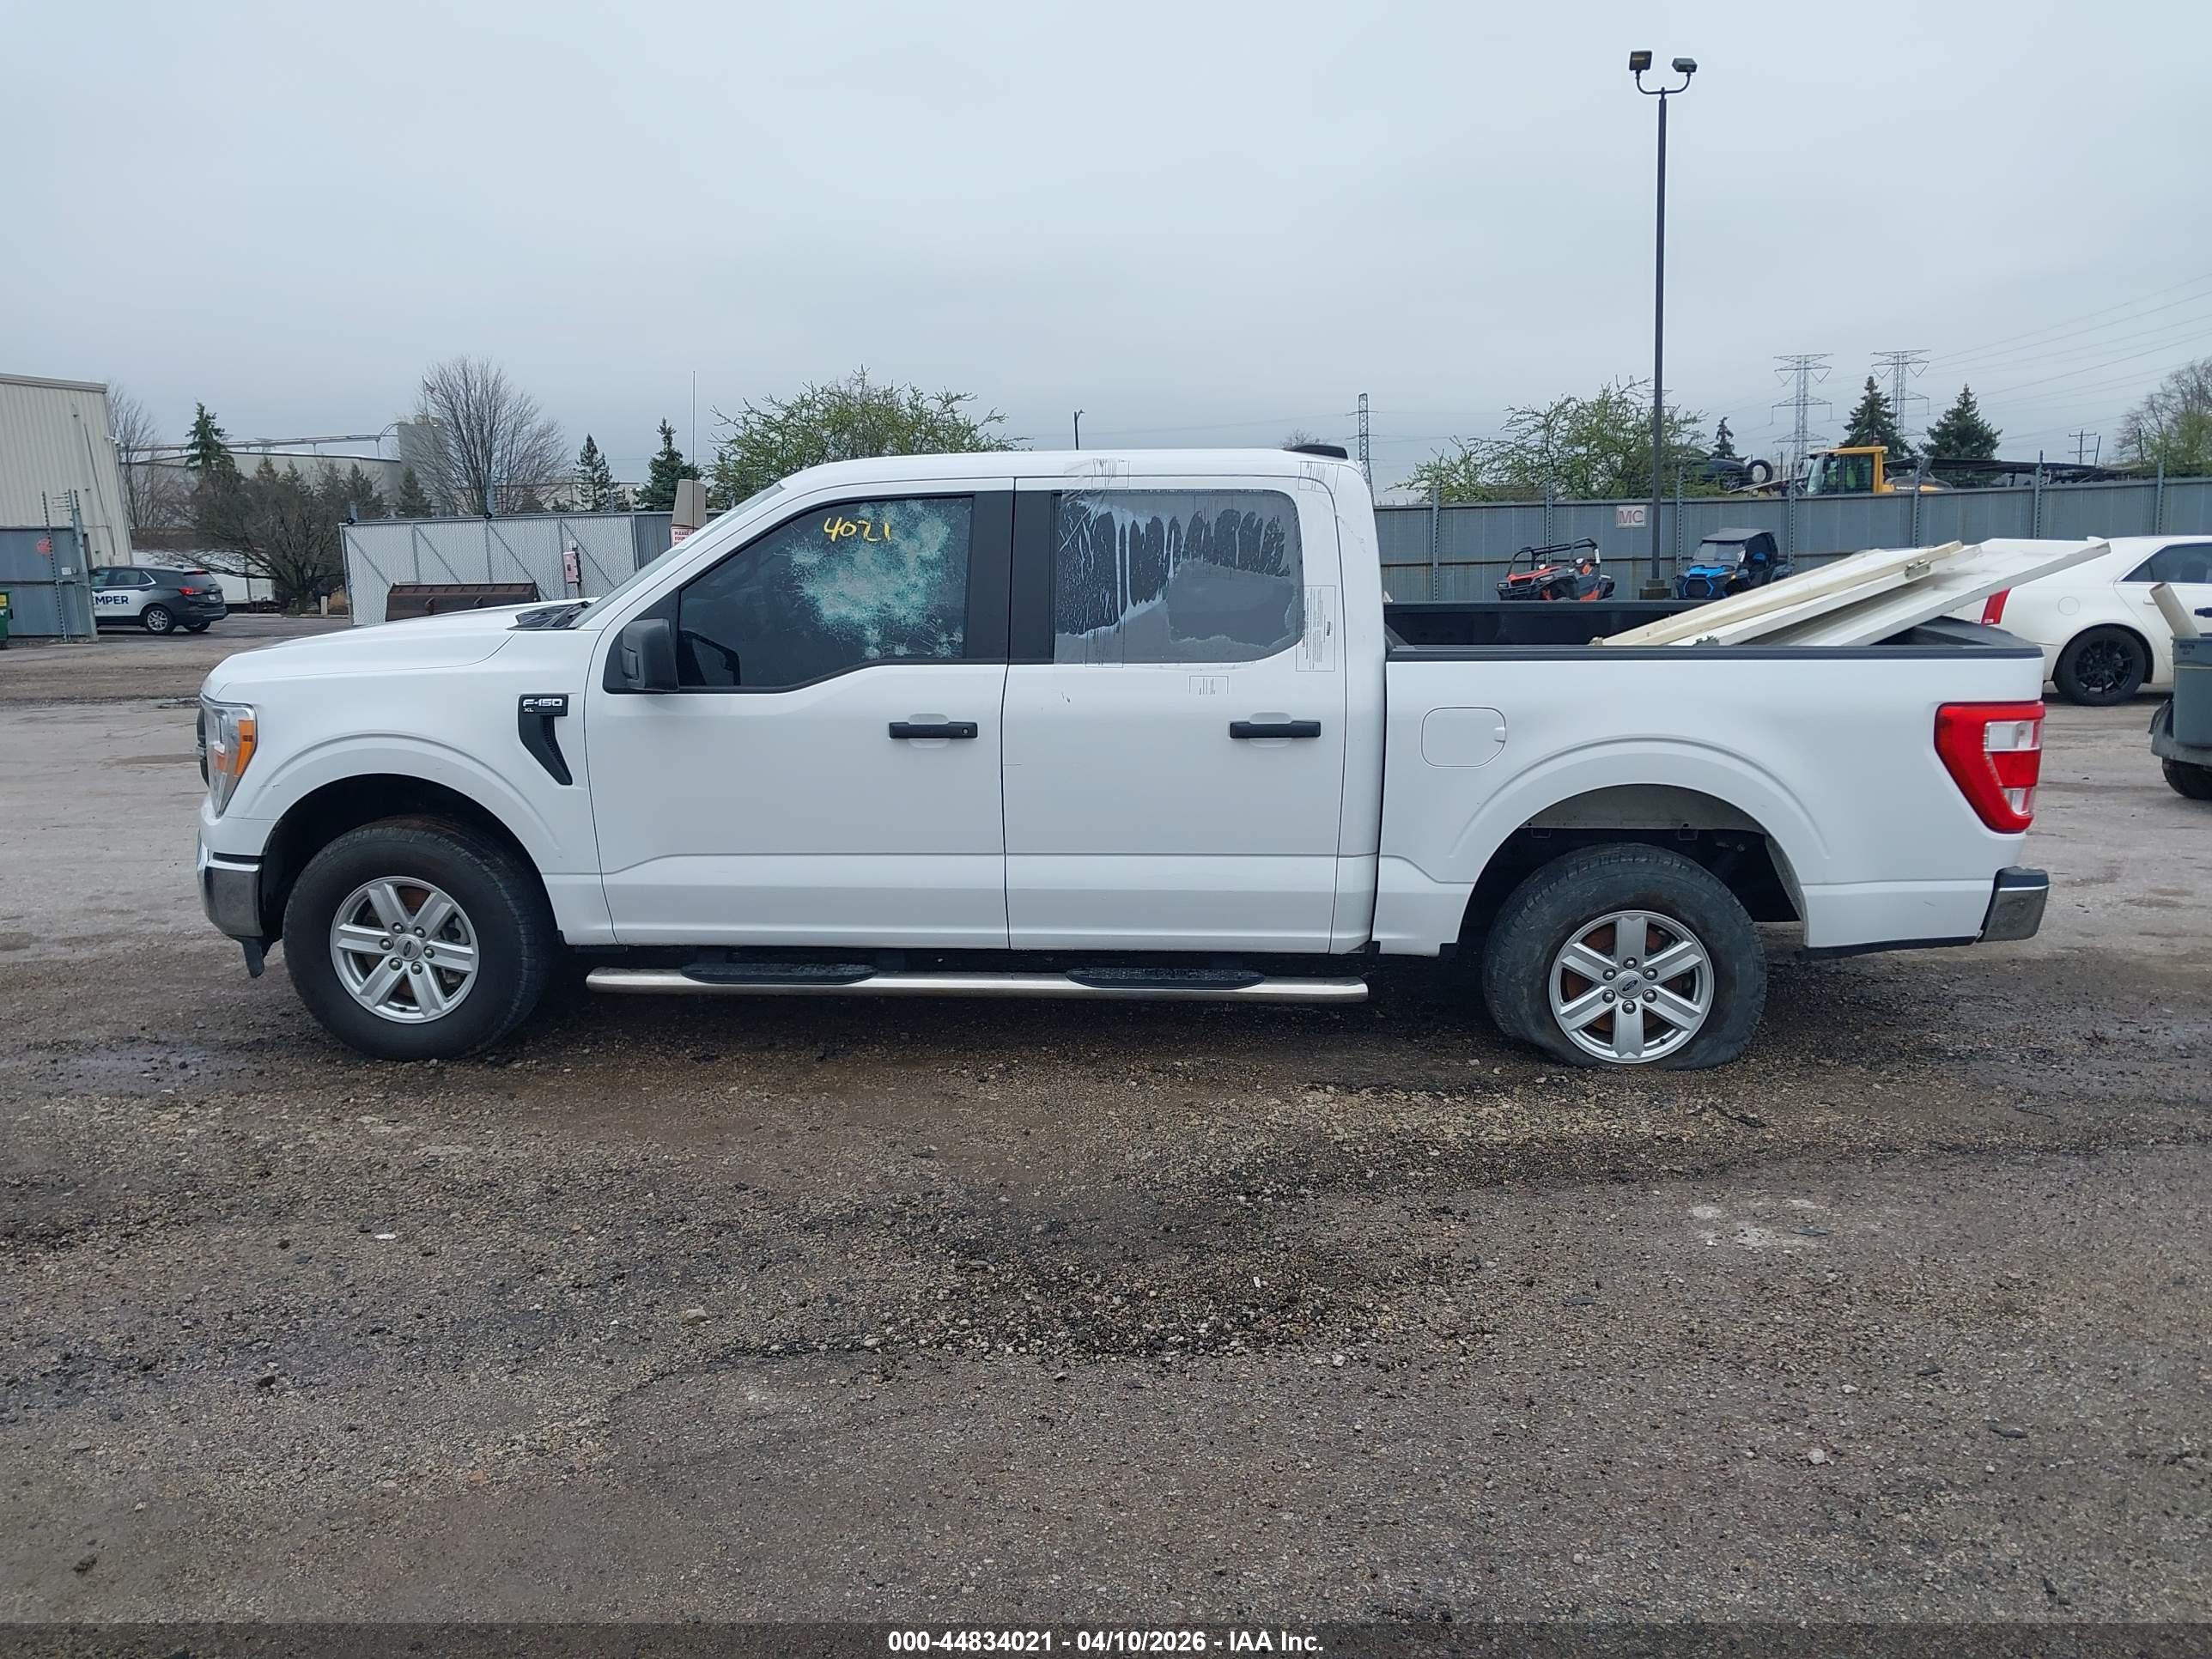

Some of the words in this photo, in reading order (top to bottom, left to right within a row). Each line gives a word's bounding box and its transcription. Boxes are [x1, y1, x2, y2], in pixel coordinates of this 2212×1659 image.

[1620, 510, 1644, 523] MC
[823, 517, 891, 542] 4021
[522, 698, 563, 707] F-150
